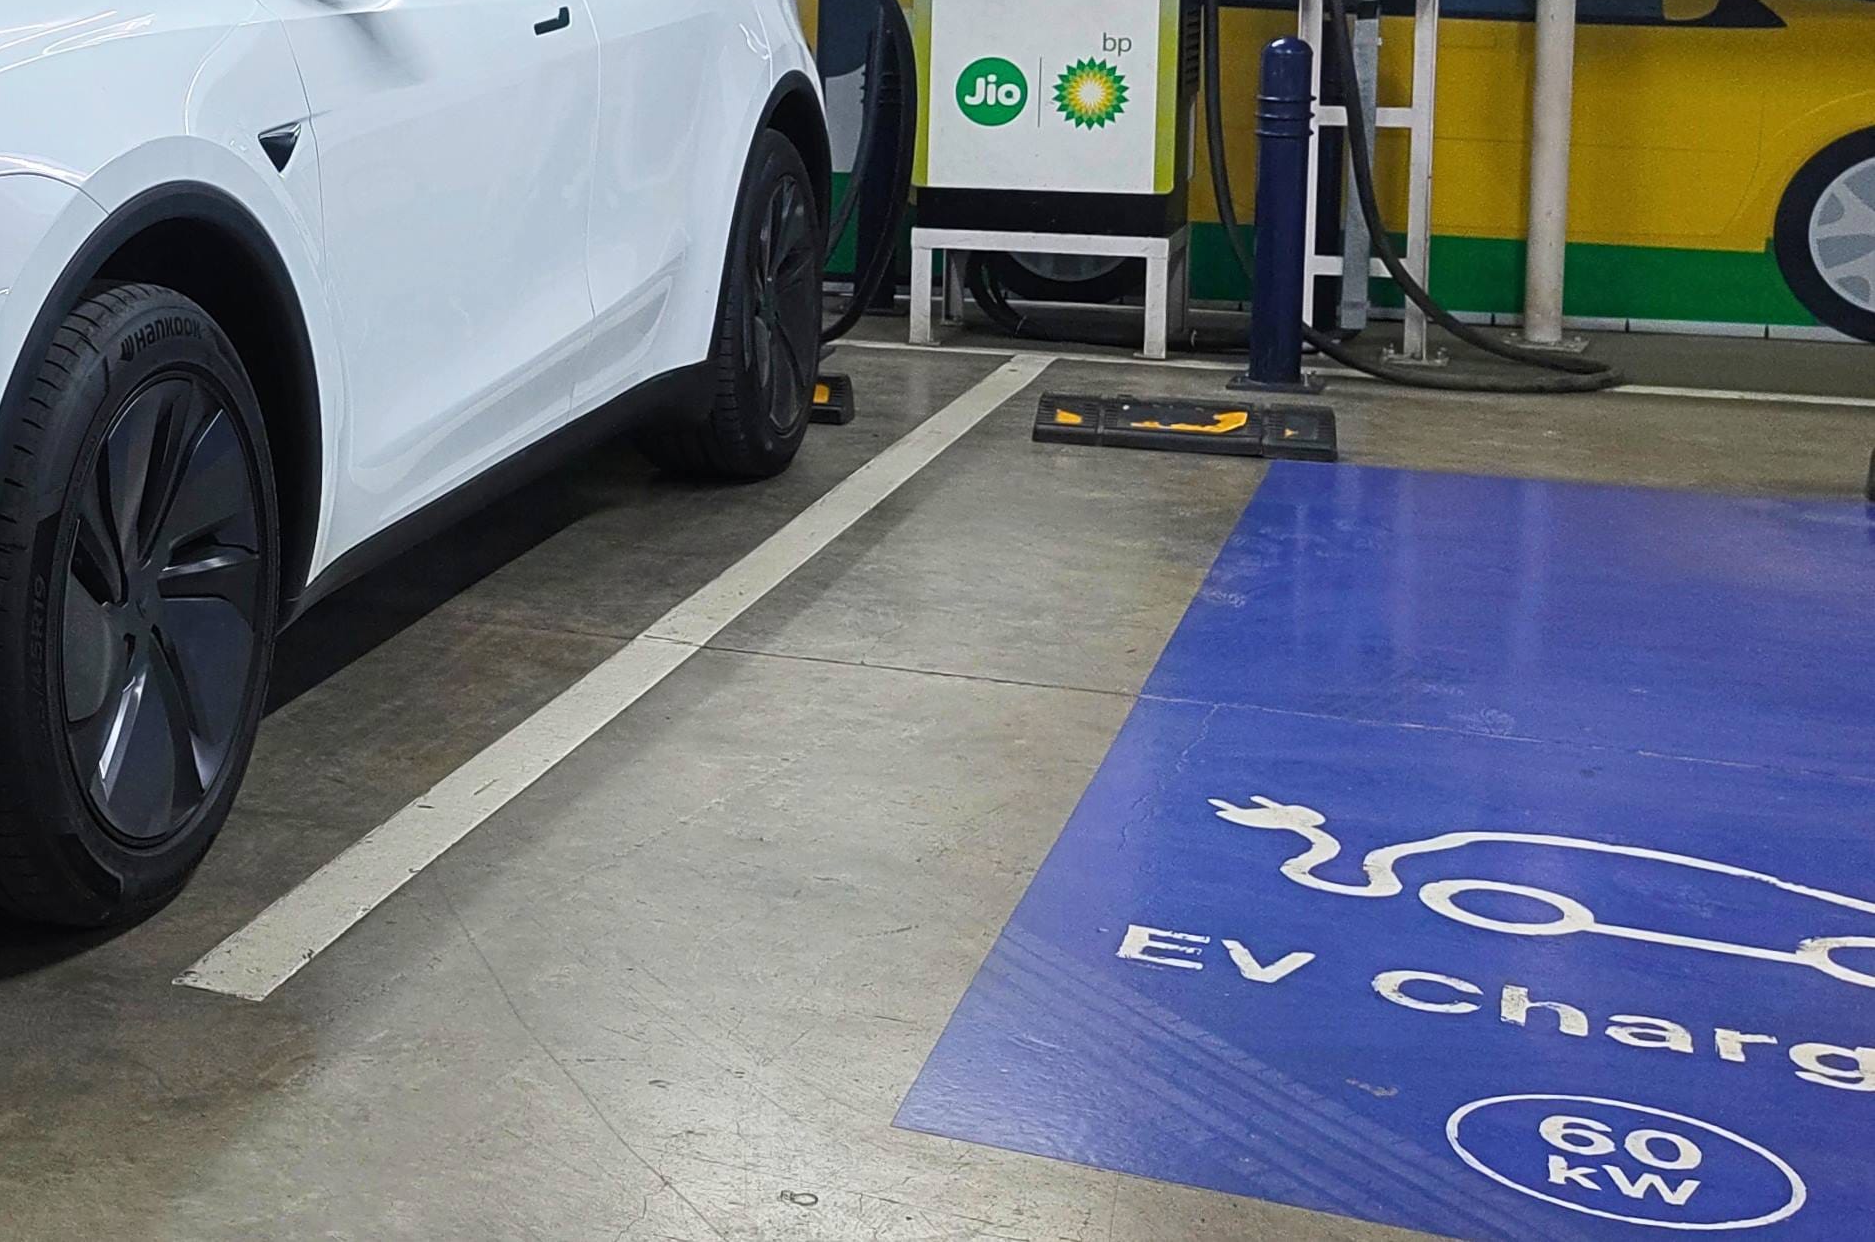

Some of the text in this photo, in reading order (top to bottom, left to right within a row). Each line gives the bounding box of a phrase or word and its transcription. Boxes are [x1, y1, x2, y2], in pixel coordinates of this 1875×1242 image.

[1102, 31, 1133, 57] bp
[964, 74, 1022, 106] Jio
[1115, 921, 1316, 984] EV
[1371, 969, 1875, 1092] Charg
[1538, 1114, 1703, 1171] 60
